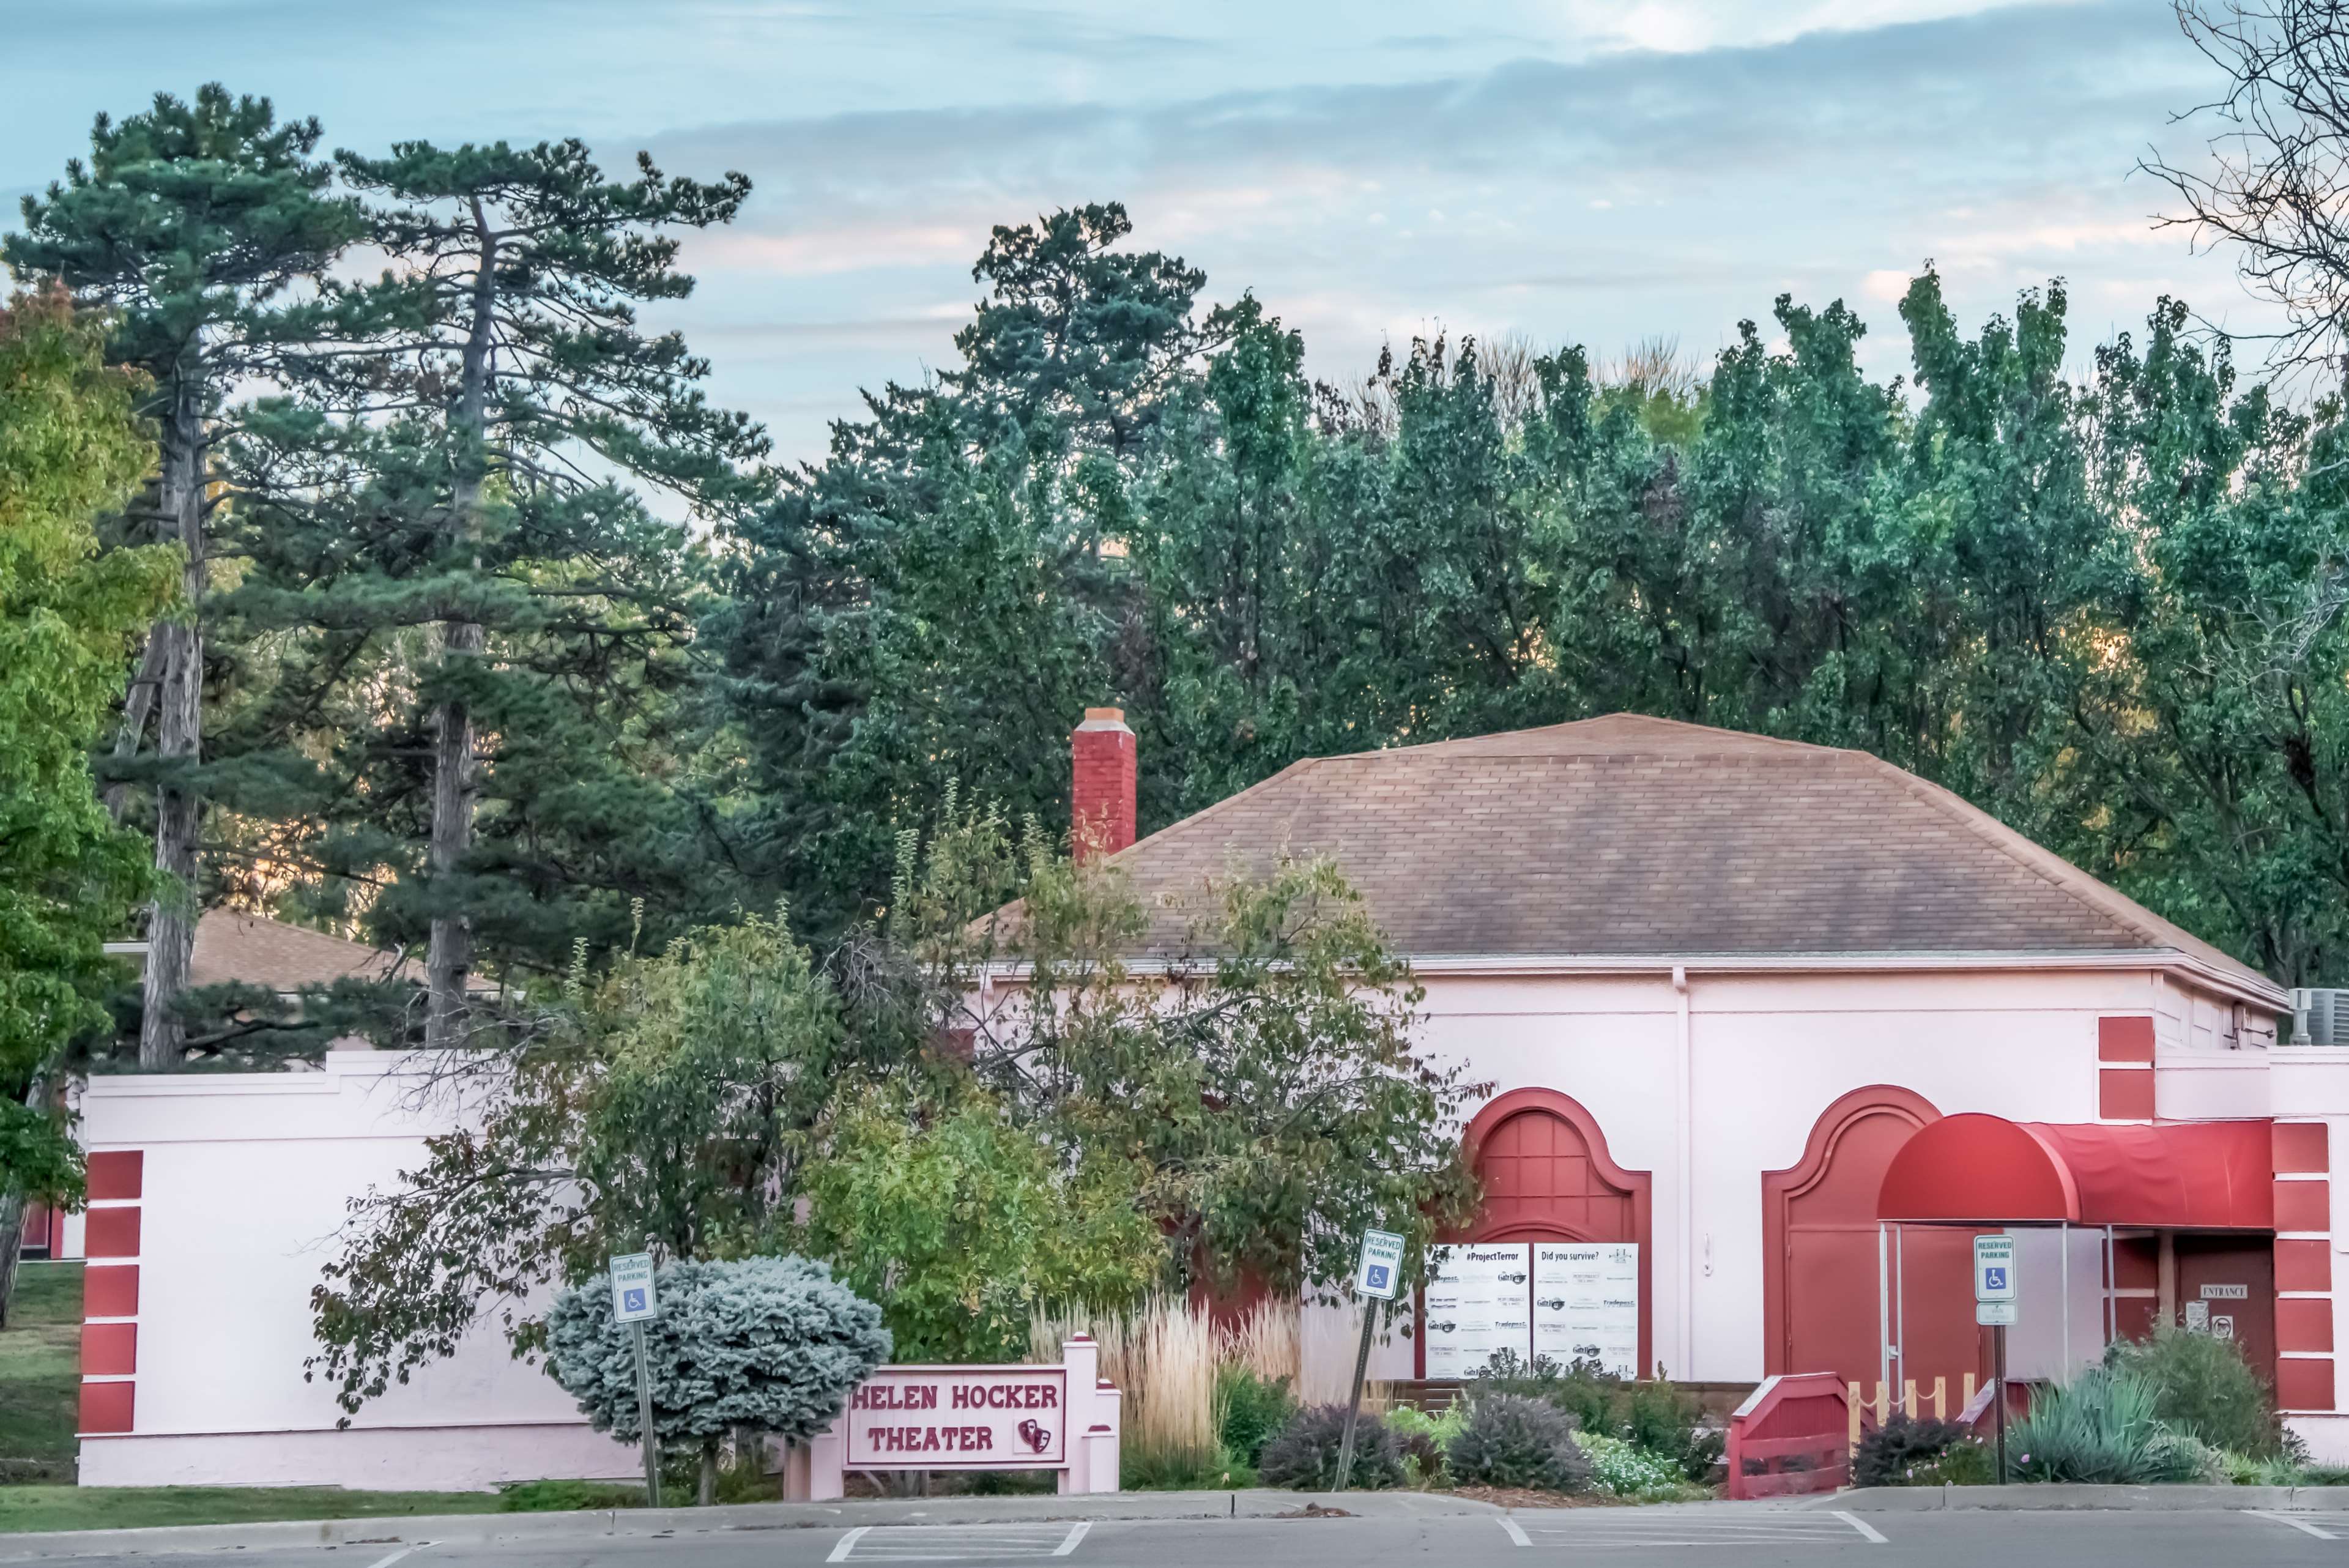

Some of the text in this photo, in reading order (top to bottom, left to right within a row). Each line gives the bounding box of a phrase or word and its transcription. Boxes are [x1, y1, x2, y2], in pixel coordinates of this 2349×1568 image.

[1367, 1236, 1401, 1250] RESERVED
[1978, 1241, 2012, 1250] RESERVED
[1368, 1247, 1397, 1261] PARKING
[1466, 1252, 1519, 1263] #ProjectTerror
[1542, 1251, 1600, 1263] Did you survive?
[614, 1260, 649, 1272] RESERVED
[618, 1271, 648, 1282] PARKING
[2203, 1287, 2246, 1298] ENTRANCE
[851, 1384, 1058, 1410] HELEN HOCKER
[867, 1426, 993, 1452] THEATER
